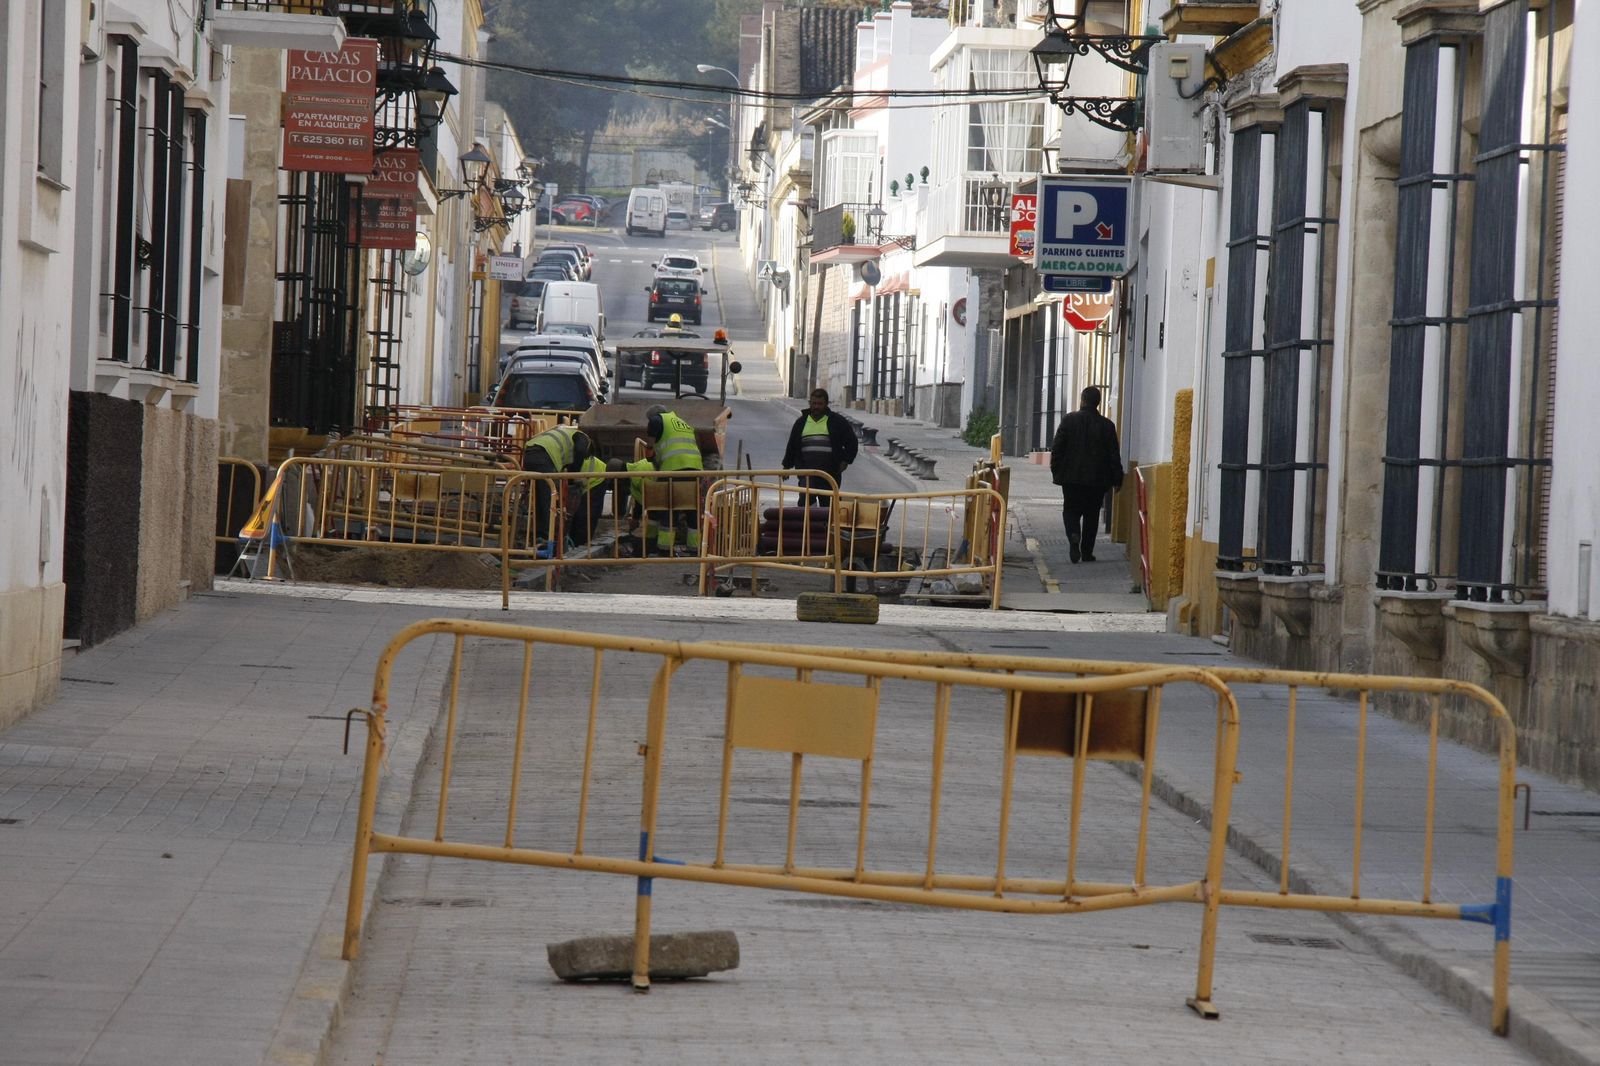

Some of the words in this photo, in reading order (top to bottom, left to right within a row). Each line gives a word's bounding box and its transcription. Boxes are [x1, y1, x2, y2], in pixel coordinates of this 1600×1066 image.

[304, 49, 361, 65] CASAS
[291, 65, 372, 84] PALACIO
[291, 112, 369, 123] APARTAMENTOS
[298, 119, 312, 128] EN
[313, 120, 361, 130] ALQUILER
[292, 134, 300, 143] T.
[302, 135, 323, 144] 625
[324, 136, 345, 146] 360
[348, 137, 364, 146] 161
[372, 157, 407, 169] ASAS
[1055, 190, 1098, 240] P
[1042, 247, 1083, 257] PARKING
[1085, 248, 1125, 259] CLIENTES
[1041, 260, 1124, 273] MERCADONA
[1065, 279, 1088, 288] LIBRE
